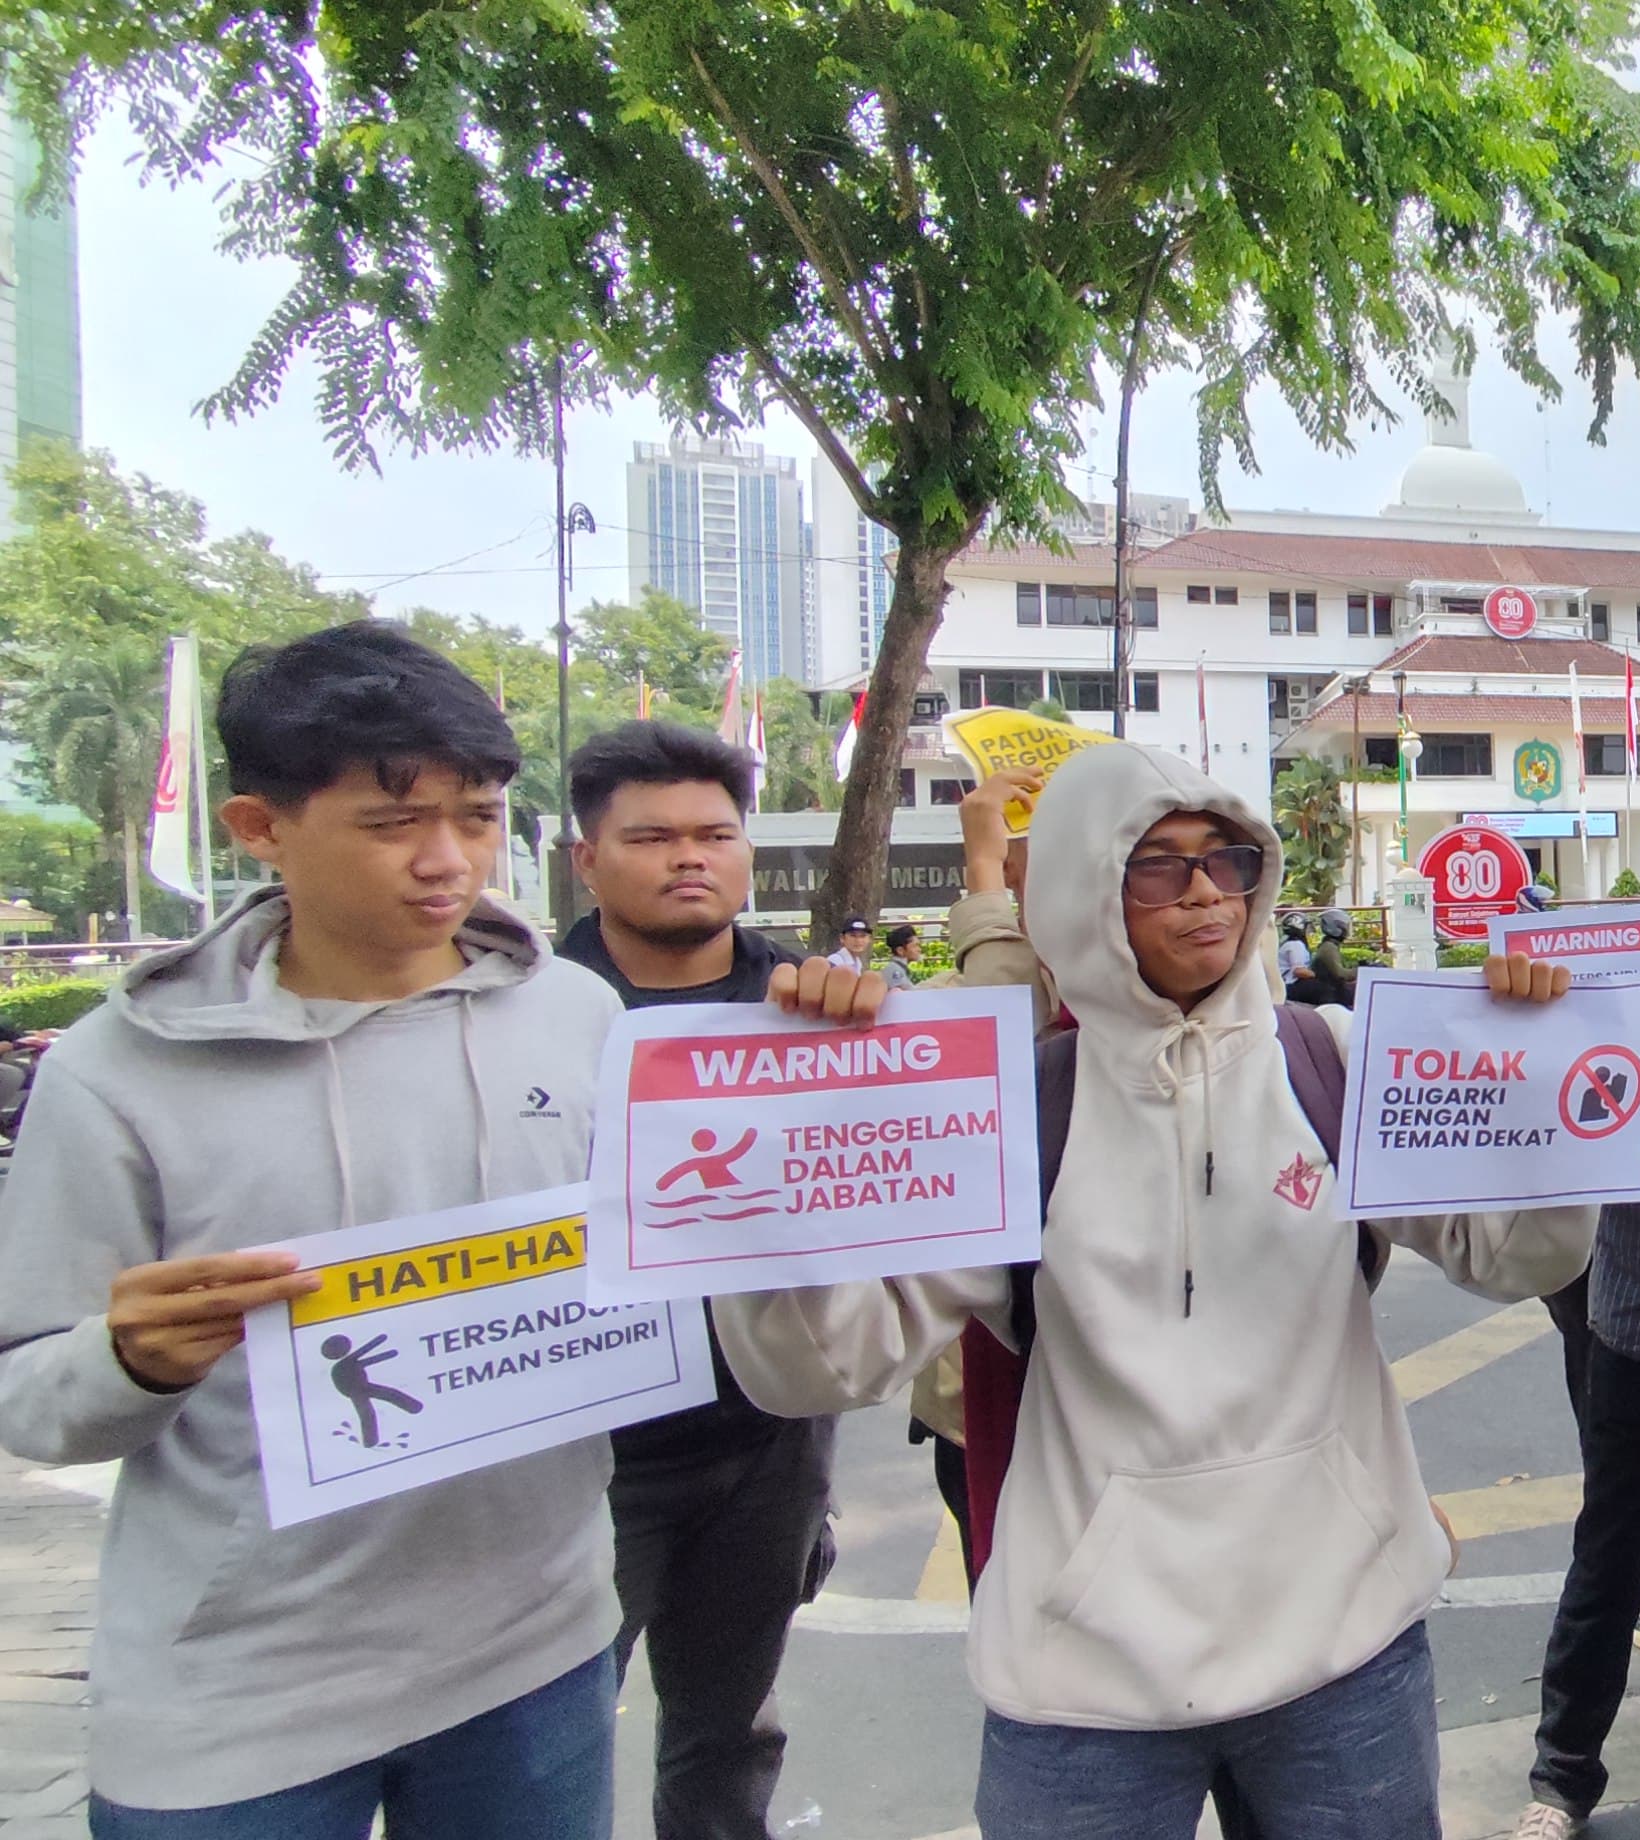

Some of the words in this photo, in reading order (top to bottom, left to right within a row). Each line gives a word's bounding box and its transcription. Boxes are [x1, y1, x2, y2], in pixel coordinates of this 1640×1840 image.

[988, 738, 1098, 771] REGULA
[1446, 850, 1501, 898] 80
[1530, 928, 1640, 953] WARNING
[691, 1035, 941, 1087] WARNING
[1387, 1048, 1528, 1081] TOLAK
[1383, 1087, 1506, 1105] OLIGARKI
[782, 1109, 997, 1153] TENGGELAM
[1380, 1109, 1490, 1126] DENGAN
[1378, 1130, 1469, 1149] TEMAN
[1475, 1128, 1558, 1147] DEKAT
[783, 1148, 913, 1184] DALAM
[785, 1173, 956, 1214] JABATAN
[348, 1225, 588, 1302] HATI-HAT
[420, 1301, 651, 1357] TERSAND
[428, 1349, 541, 1394] TEMAN
[547, 1319, 658, 1363] SENDIRI
